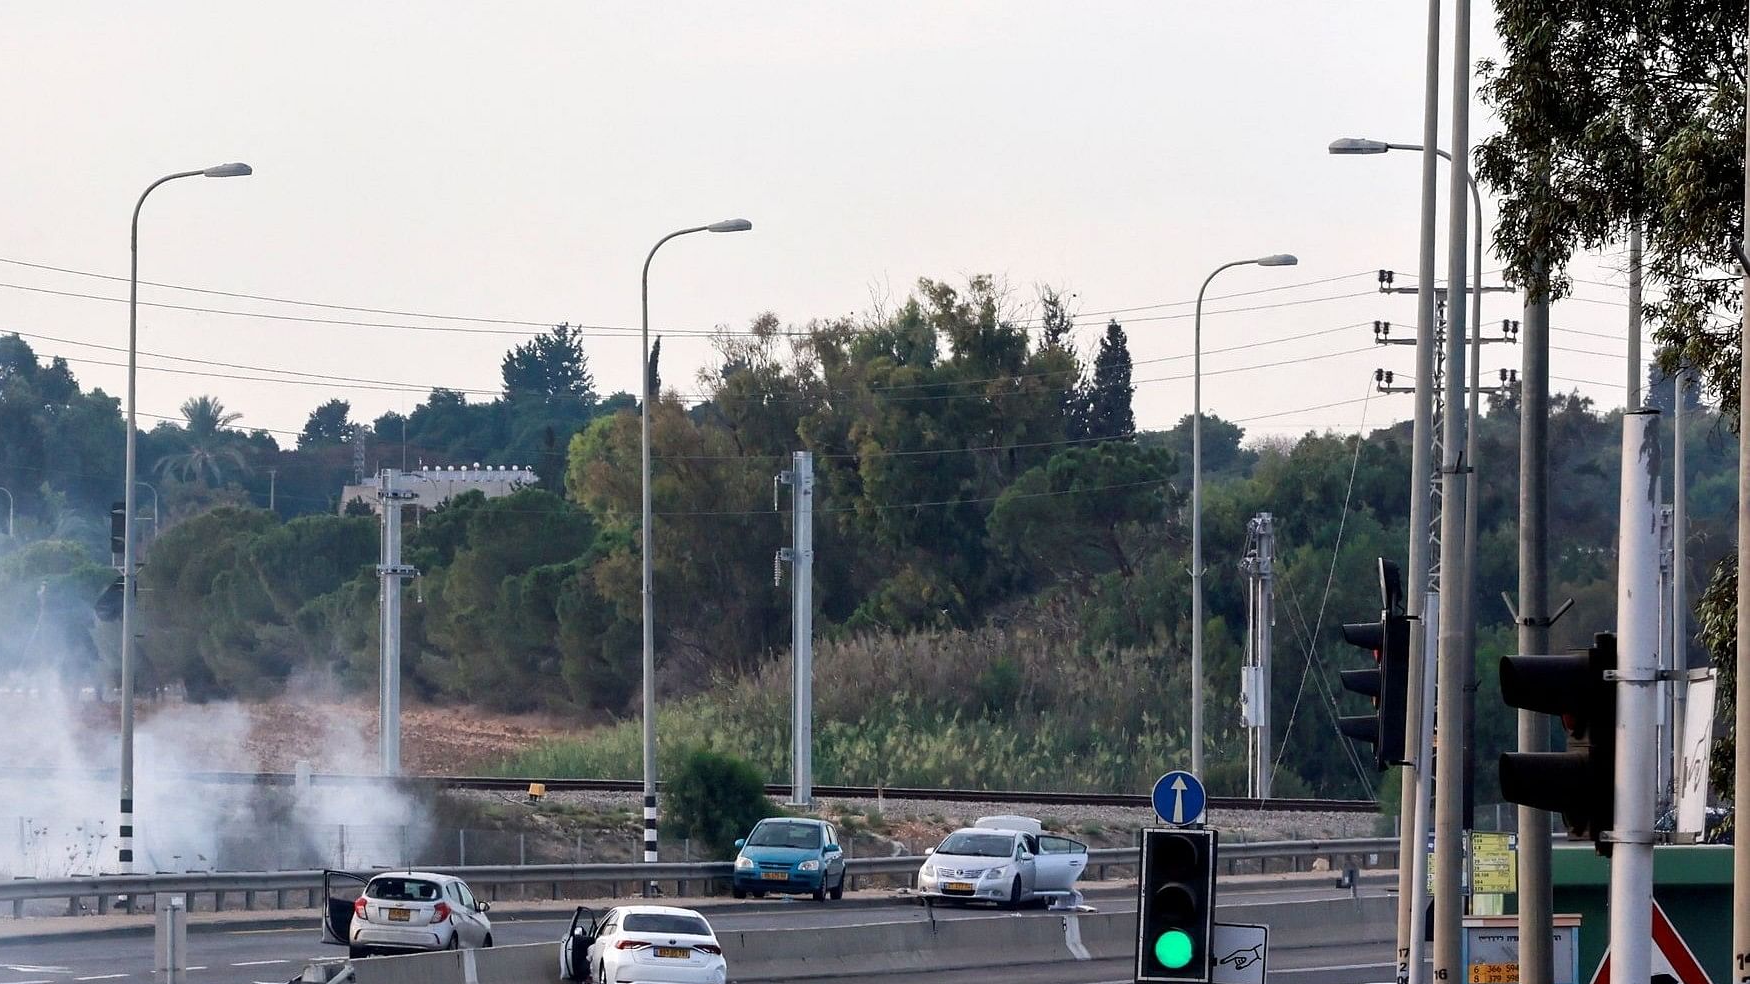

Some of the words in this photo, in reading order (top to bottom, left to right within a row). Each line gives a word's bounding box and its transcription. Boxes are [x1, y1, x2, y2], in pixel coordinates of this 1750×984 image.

[1399, 948, 1410, 958] 17
[1399, 962, 1407, 972] 2
[1473, 965, 1480, 974] 6
[1434, 968, 1448, 980] 16
[1473, 975, 1480, 983] 8
